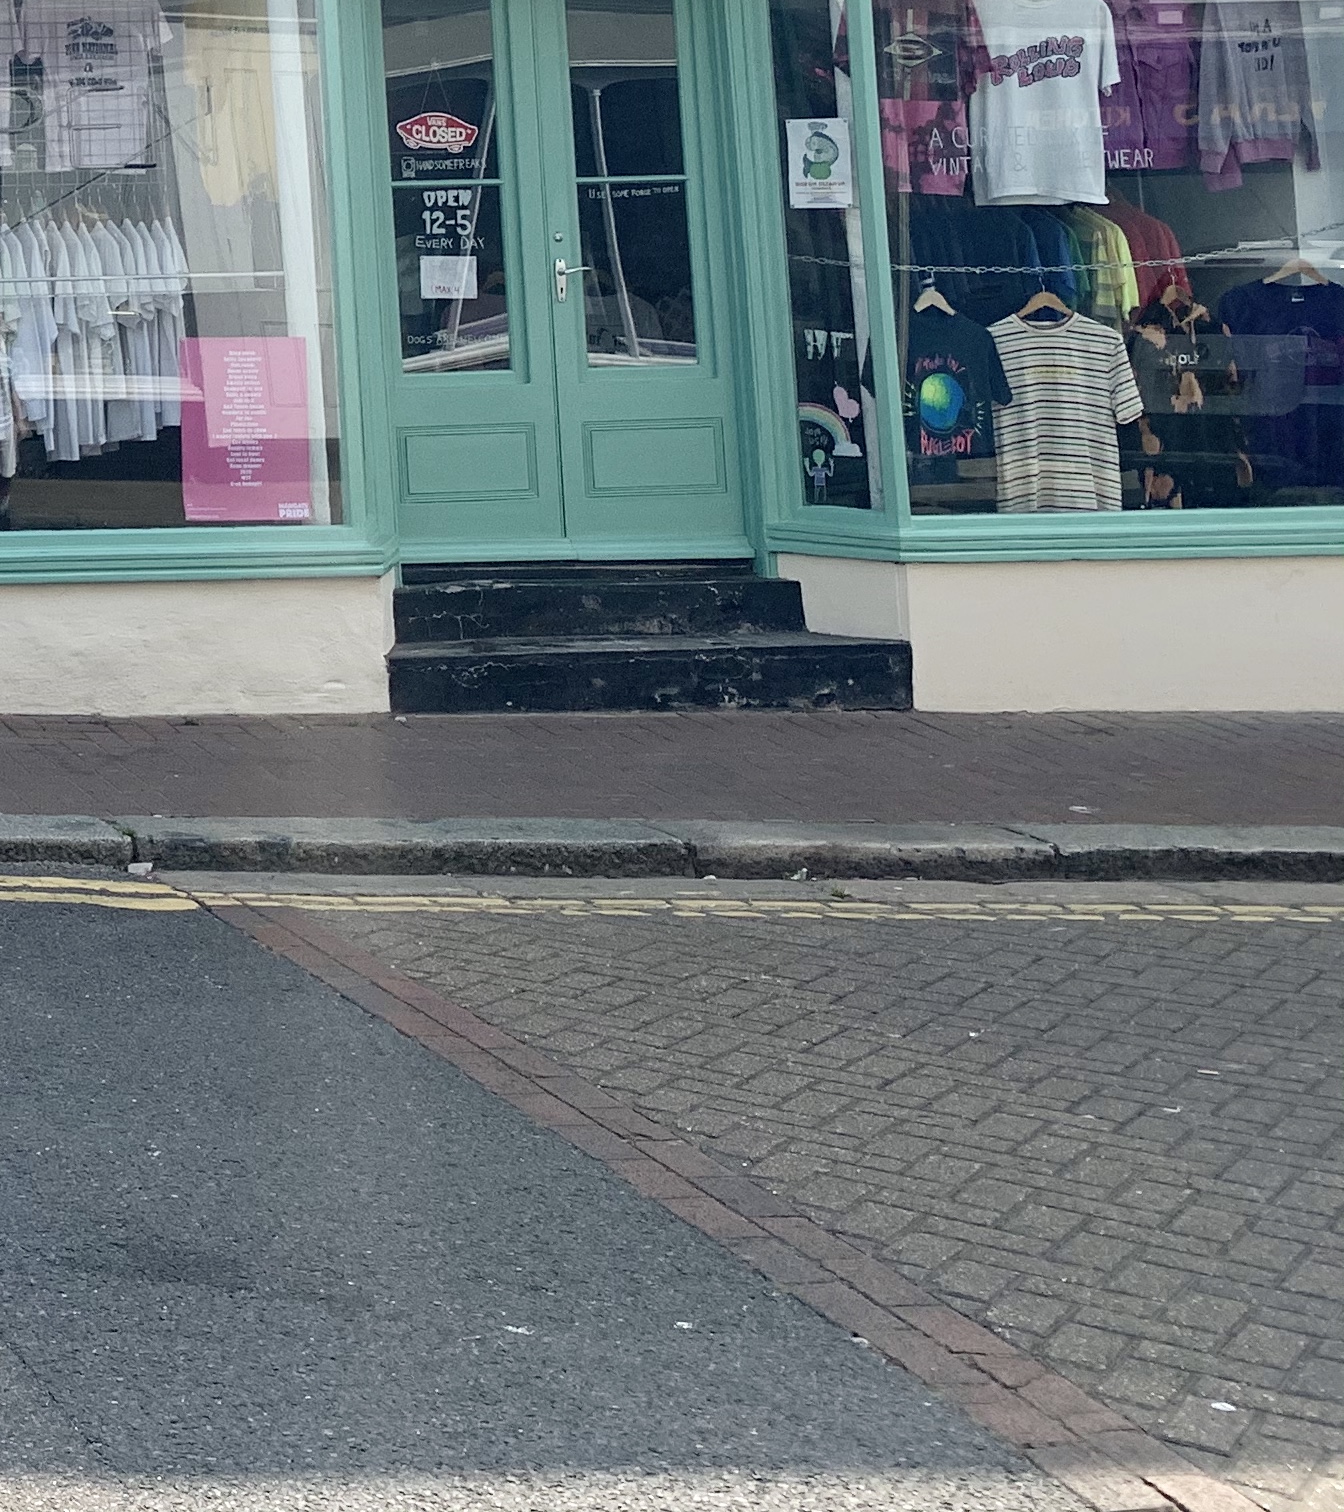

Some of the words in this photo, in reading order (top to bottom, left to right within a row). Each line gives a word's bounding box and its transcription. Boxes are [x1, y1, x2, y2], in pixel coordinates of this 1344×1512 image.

[991, 35, 1085, 86] ROLLING
[426, 116, 447, 126] VANS
[411, 125, 466, 143] CLOSED
[422, 189, 473, 208] OPEN
[421, 209, 472, 236] 12-5
[415, 235, 454, 249] EVERY
[459, 235, 485, 250] DAY
[407, 335, 433, 345] DOGS
[278, 508, 310, 518] PRIDE
